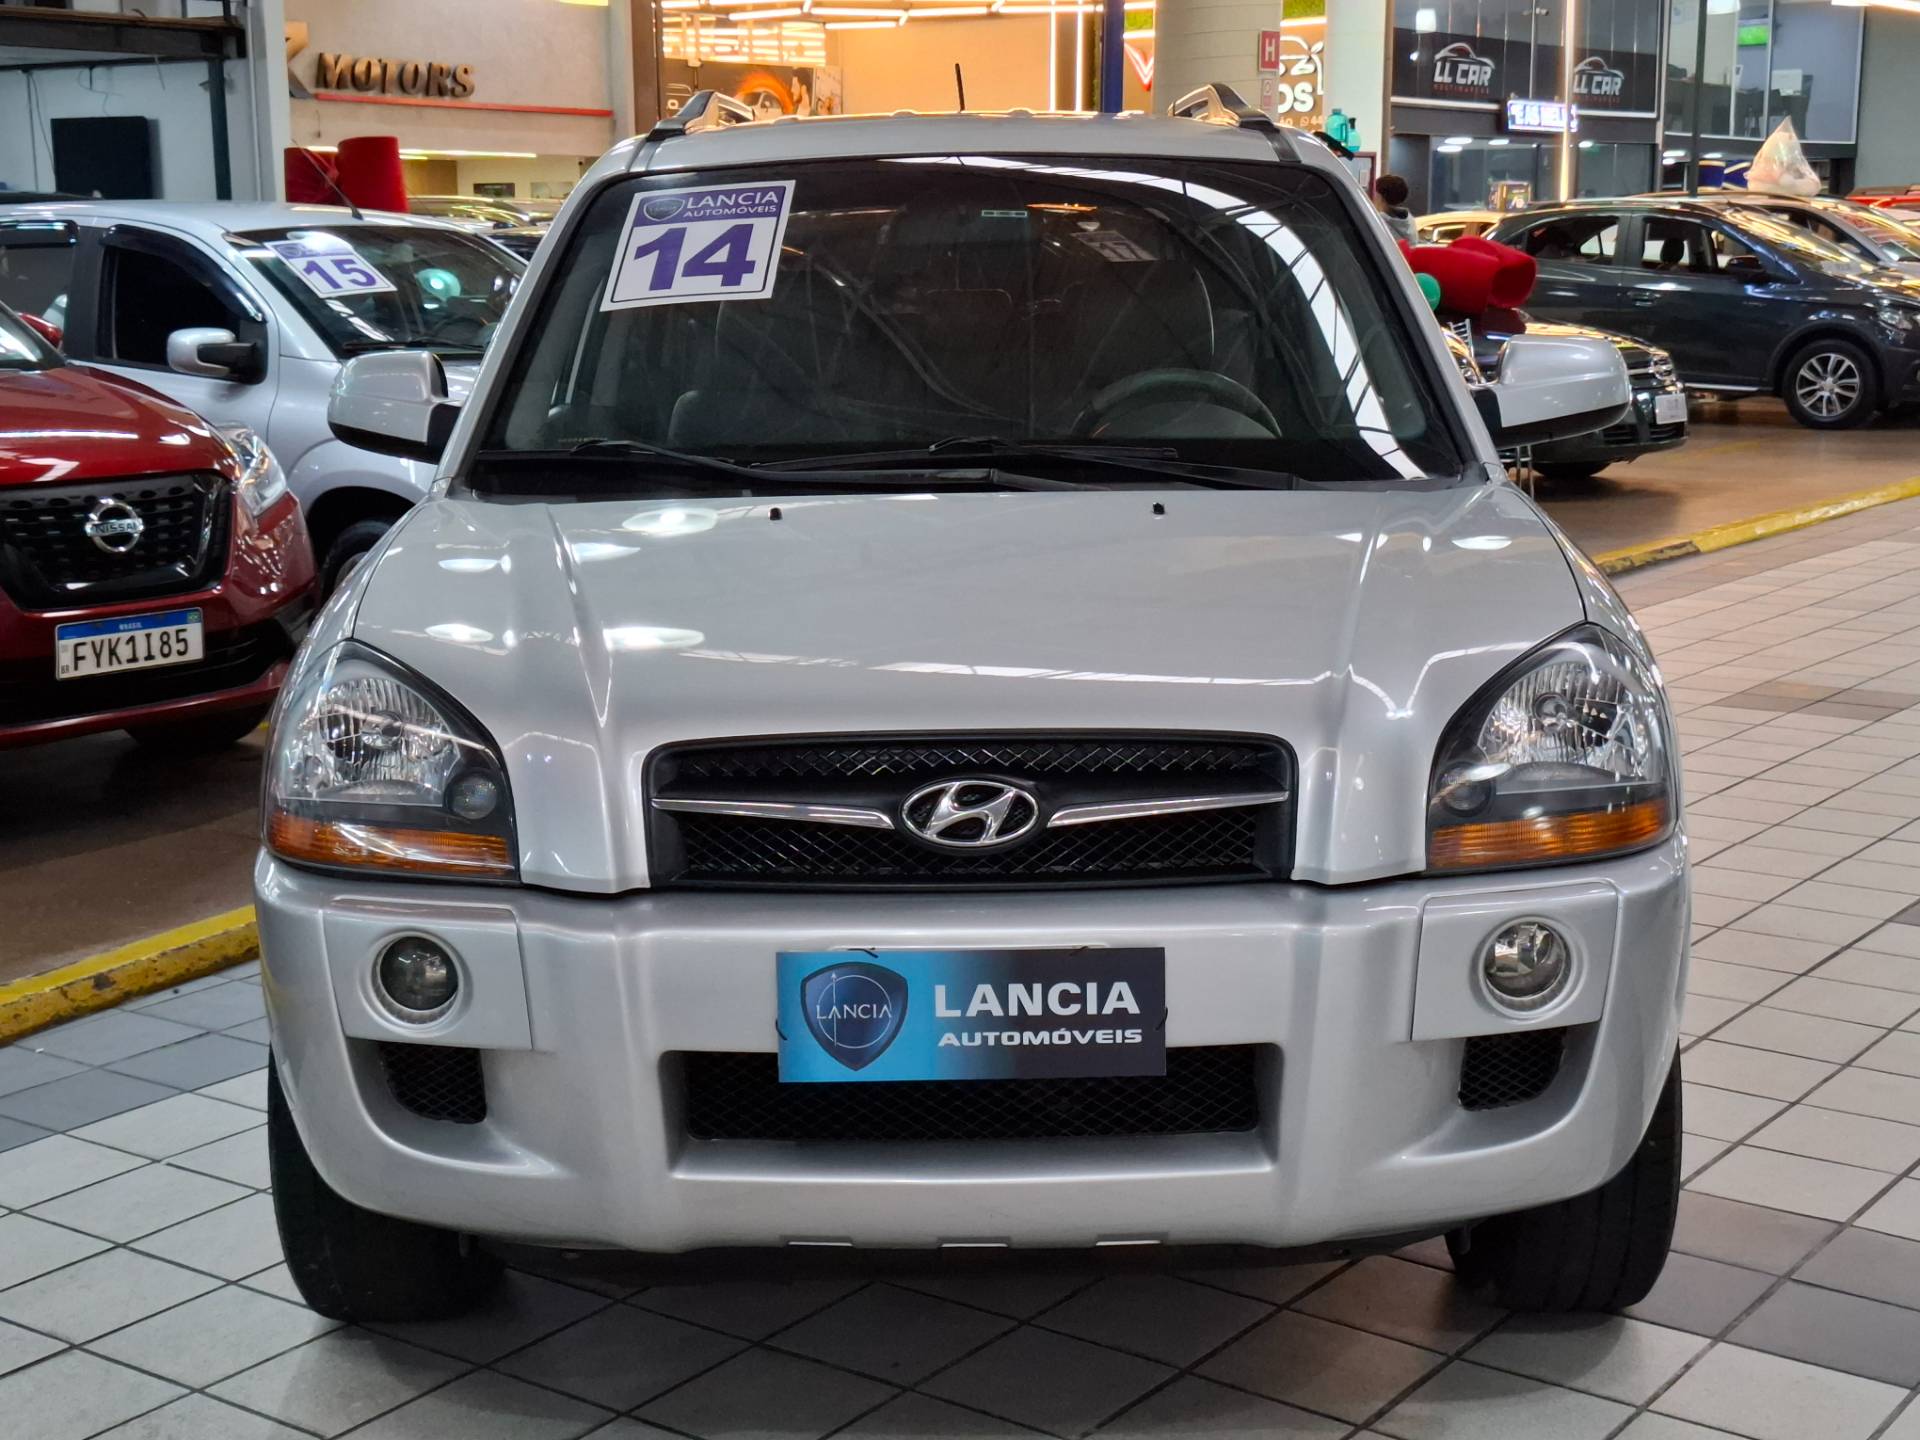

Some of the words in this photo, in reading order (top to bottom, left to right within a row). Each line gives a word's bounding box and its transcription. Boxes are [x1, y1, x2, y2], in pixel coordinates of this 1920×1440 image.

[316, 52, 476, 97] MOTORS
[1433, 60, 1452, 83] LL
[1456, 63, 1492, 86] CAR
[1591, 75, 1622, 96] CAR
[683, 205, 777, 218] AUTOMÓVEIS
[686, 191, 779, 209] LANCIA
[634, 223, 756, 292] 14
[303, 258, 377, 289] 15
[74, 628, 188, 671] FYK1I85
[816, 1003, 892, 1019] LANCIA
[934, 981, 1141, 1018] LANCIA
[938, 1027, 1142, 1047] AUTOMÓVEIS
